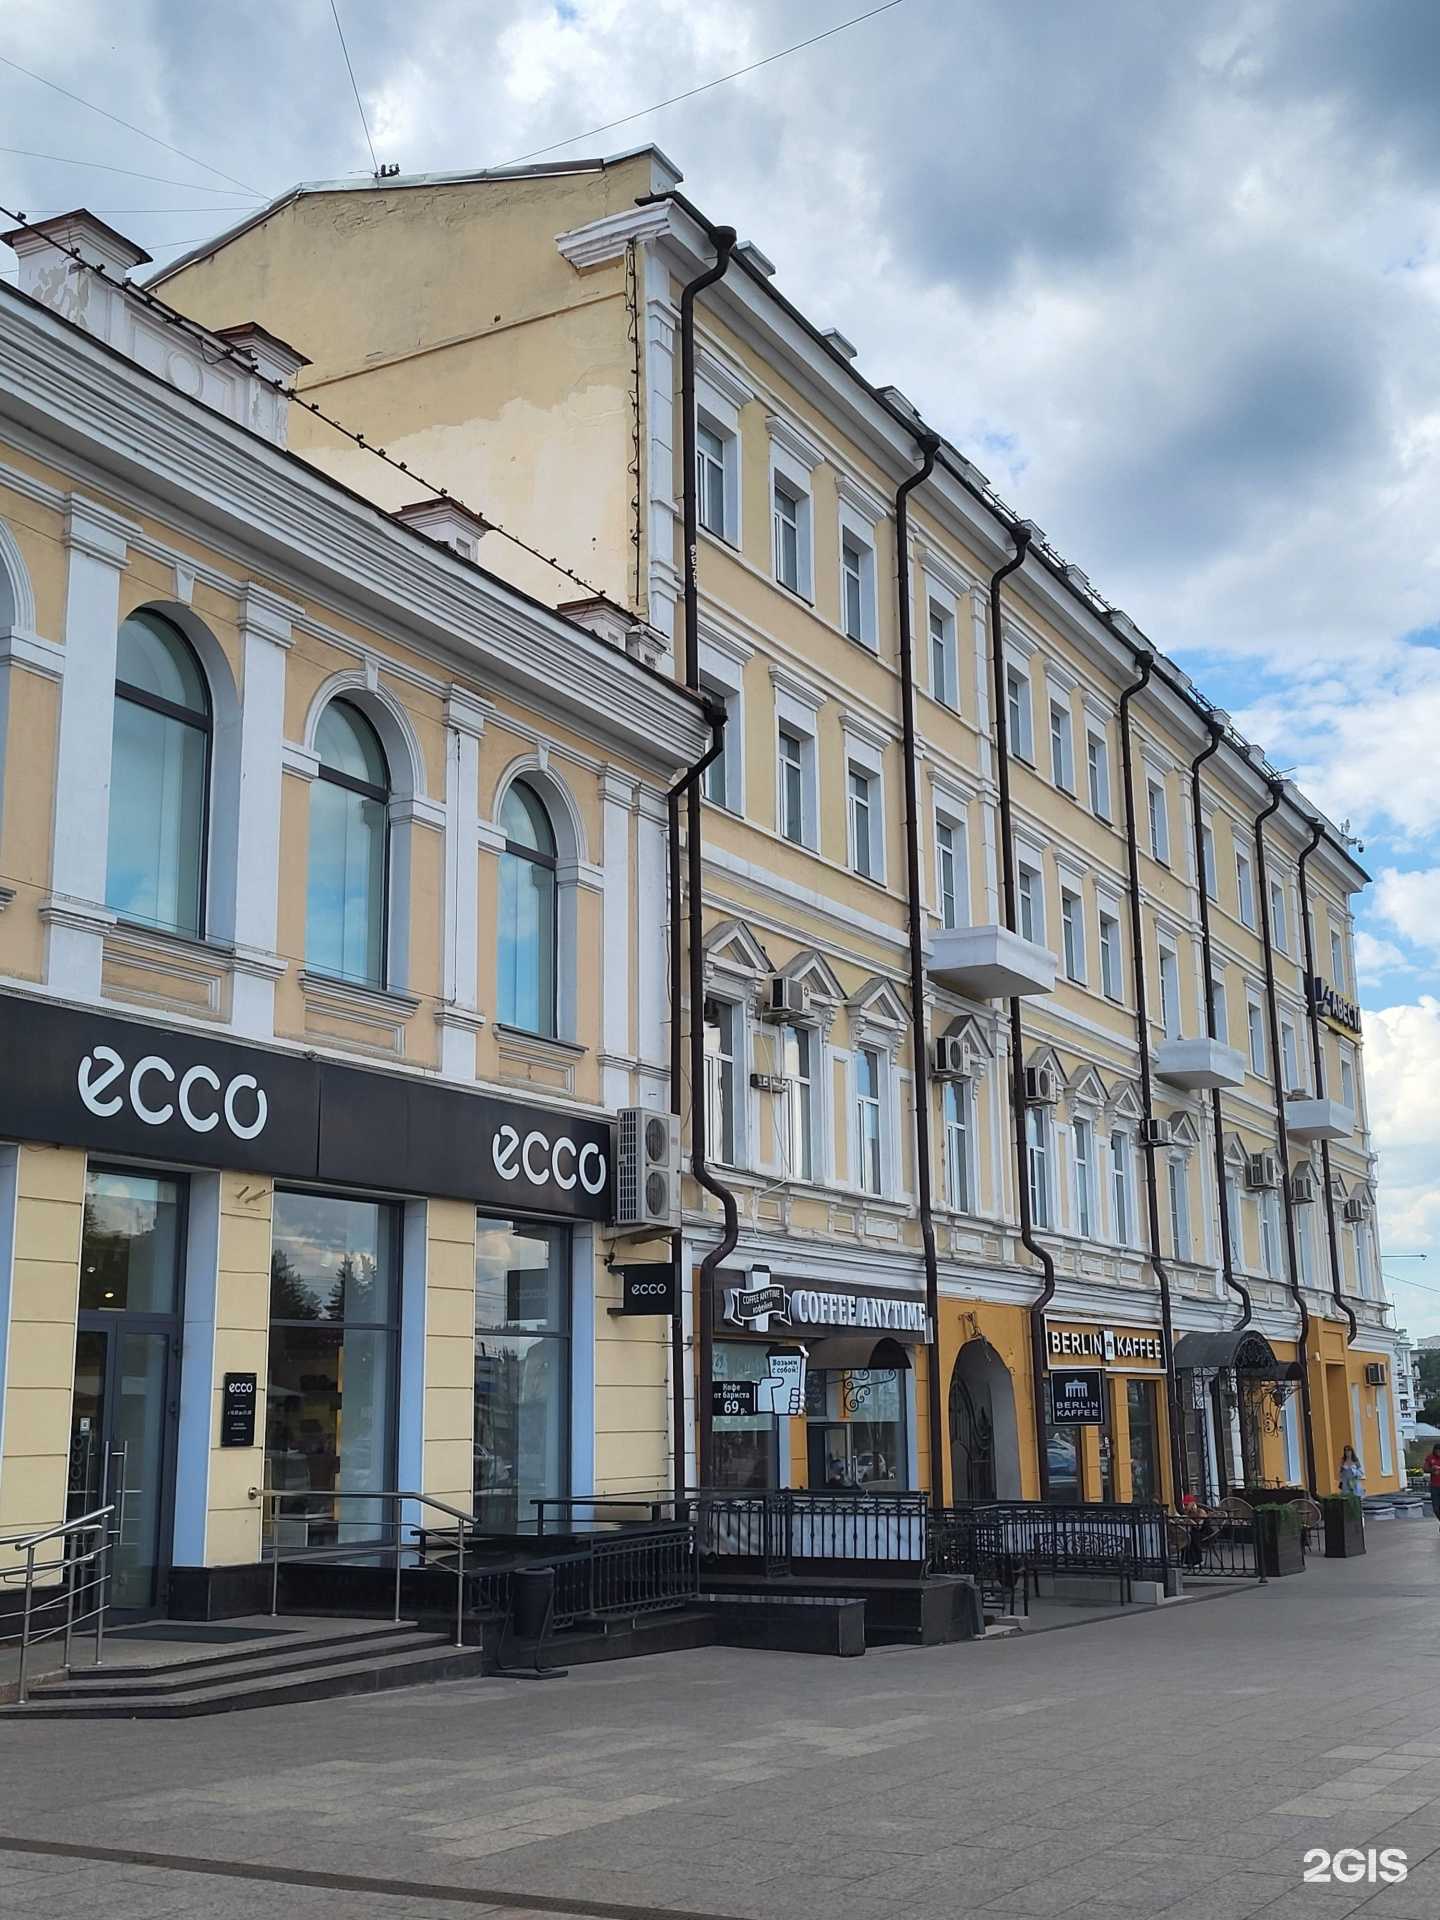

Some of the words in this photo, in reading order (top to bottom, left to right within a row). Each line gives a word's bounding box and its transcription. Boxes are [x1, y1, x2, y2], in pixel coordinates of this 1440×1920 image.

[78, 1045, 268, 1140] ecco
[492, 1125, 606, 1195] ecco
[631, 1283, 667, 1295] ecco
[742, 1293, 760, 1305] COFFEE
[760, 1289, 781, 1302] ANYTIME
[795, 1290, 857, 1326] COFFEE
[858, 1297, 926, 1331] ANYTIME
[1051, 1331, 1102, 1355] BERLIN
[1116, 1336, 1162, 1358] KAFFEE
[772, 1359, 798, 1367] Возьми
[776, 1366, 799, 1374] собой!
[229, 1383, 253, 1393] ecco
[722, 1383, 741, 1393] Кофе
[722, 1391, 750, 1400] бариста
[724, 1400, 739, 1414] 69
[740, 1407, 748, 1415] р.
[1056, 1401, 1099, 1409] BERLIN
[1056, 1409, 1100, 1417] KAFFEE
